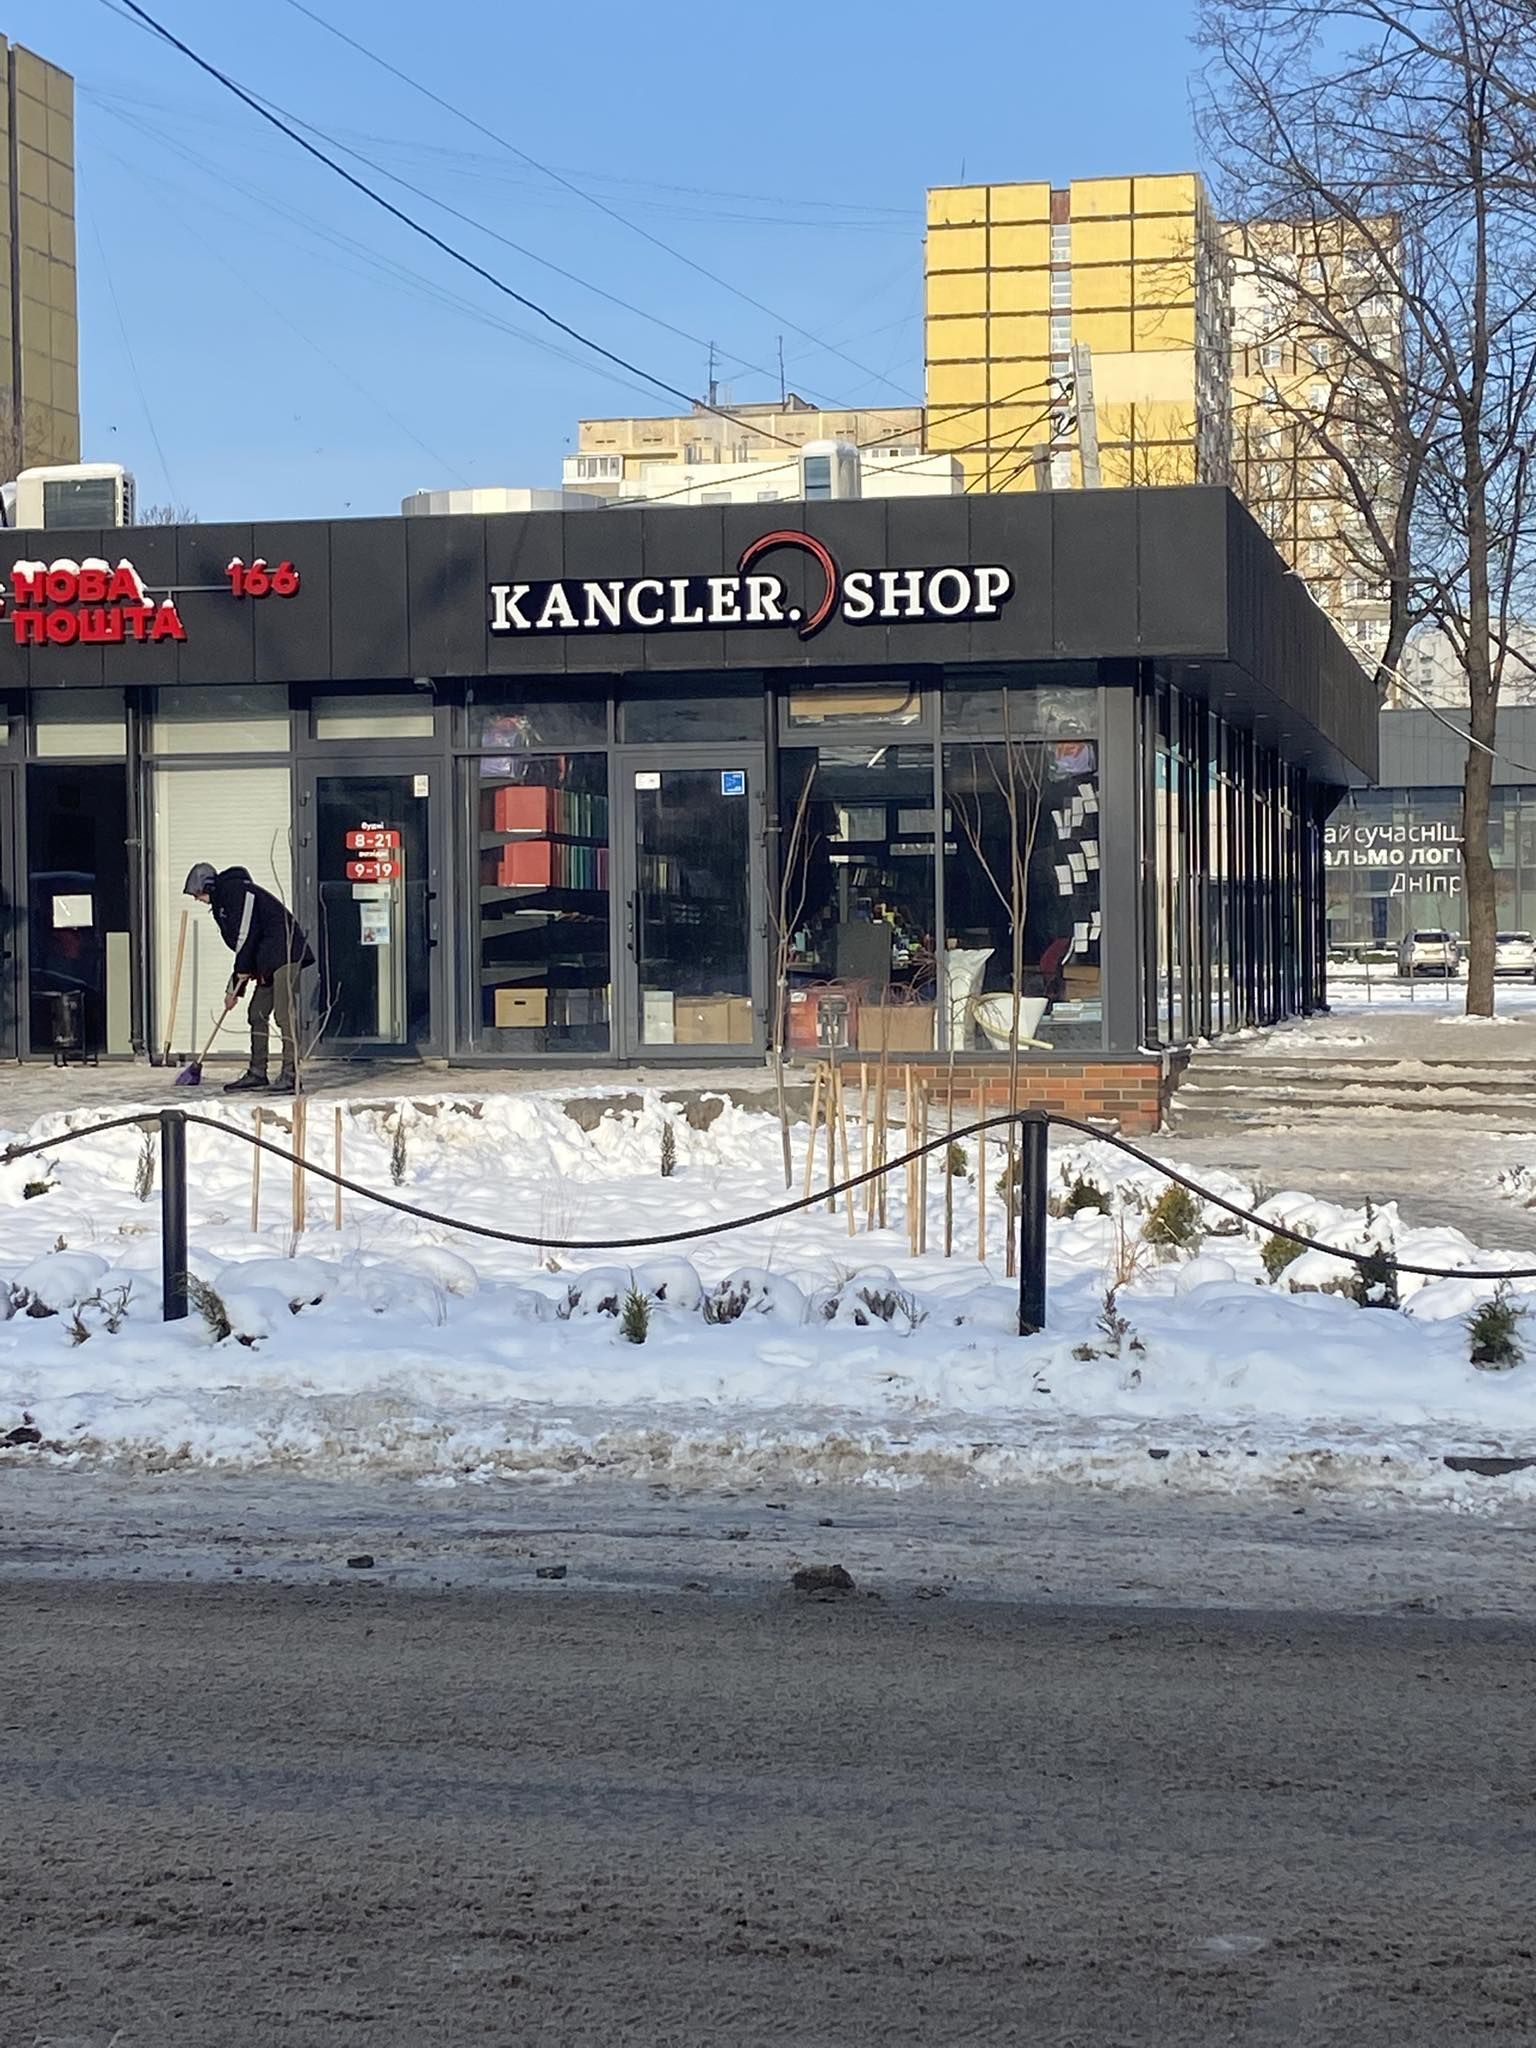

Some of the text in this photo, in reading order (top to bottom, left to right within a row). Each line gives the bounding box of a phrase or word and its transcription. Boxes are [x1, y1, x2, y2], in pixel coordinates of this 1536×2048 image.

[10, 561, 146, 605] НОВА
[226, 559, 299, 597] 166
[843, 567, 1011, 619] SHOP
[11, 605, 188, 643] ПОШТА
[355, 833, 392, 847] 8-21
[355, 863, 392, 877] 9-19
